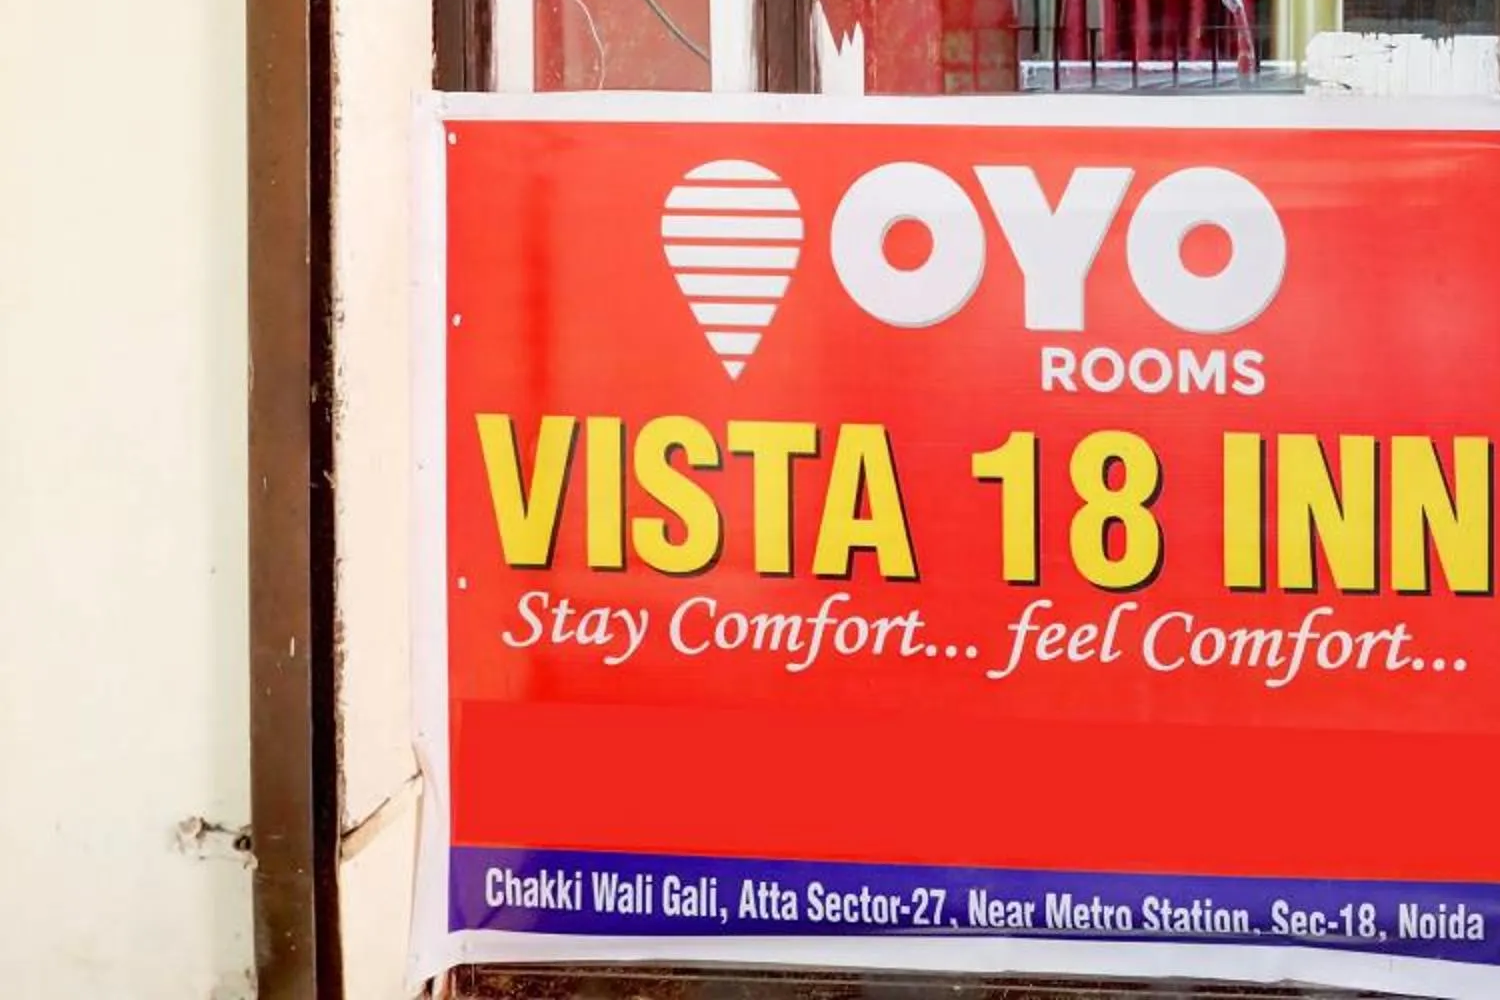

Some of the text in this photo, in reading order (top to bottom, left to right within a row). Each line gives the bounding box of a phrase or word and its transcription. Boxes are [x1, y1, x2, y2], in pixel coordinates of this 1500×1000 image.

[830, 161, 1287, 334] OYO
[1040, 346, 1265, 395] ROOMS
[475, 413, 1494, 595] VISTA 18 INN
[502, 590, 1467, 687] Stay Comfort... feel Comfort...
[485, 867, 582, 911] Chakki
[591, 871, 653, 915] Wali
[662, 875, 728, 924] Gali,
[738, 879, 799, 921] Atta
[807, 881, 957, 929] Sector-27,
[968, 888, 1036, 928] Near
[1045, 892, 1133, 932] Metro
[1271, 899, 1387, 942] Sec-18,
[1398, 902, 1484, 940] Noida
